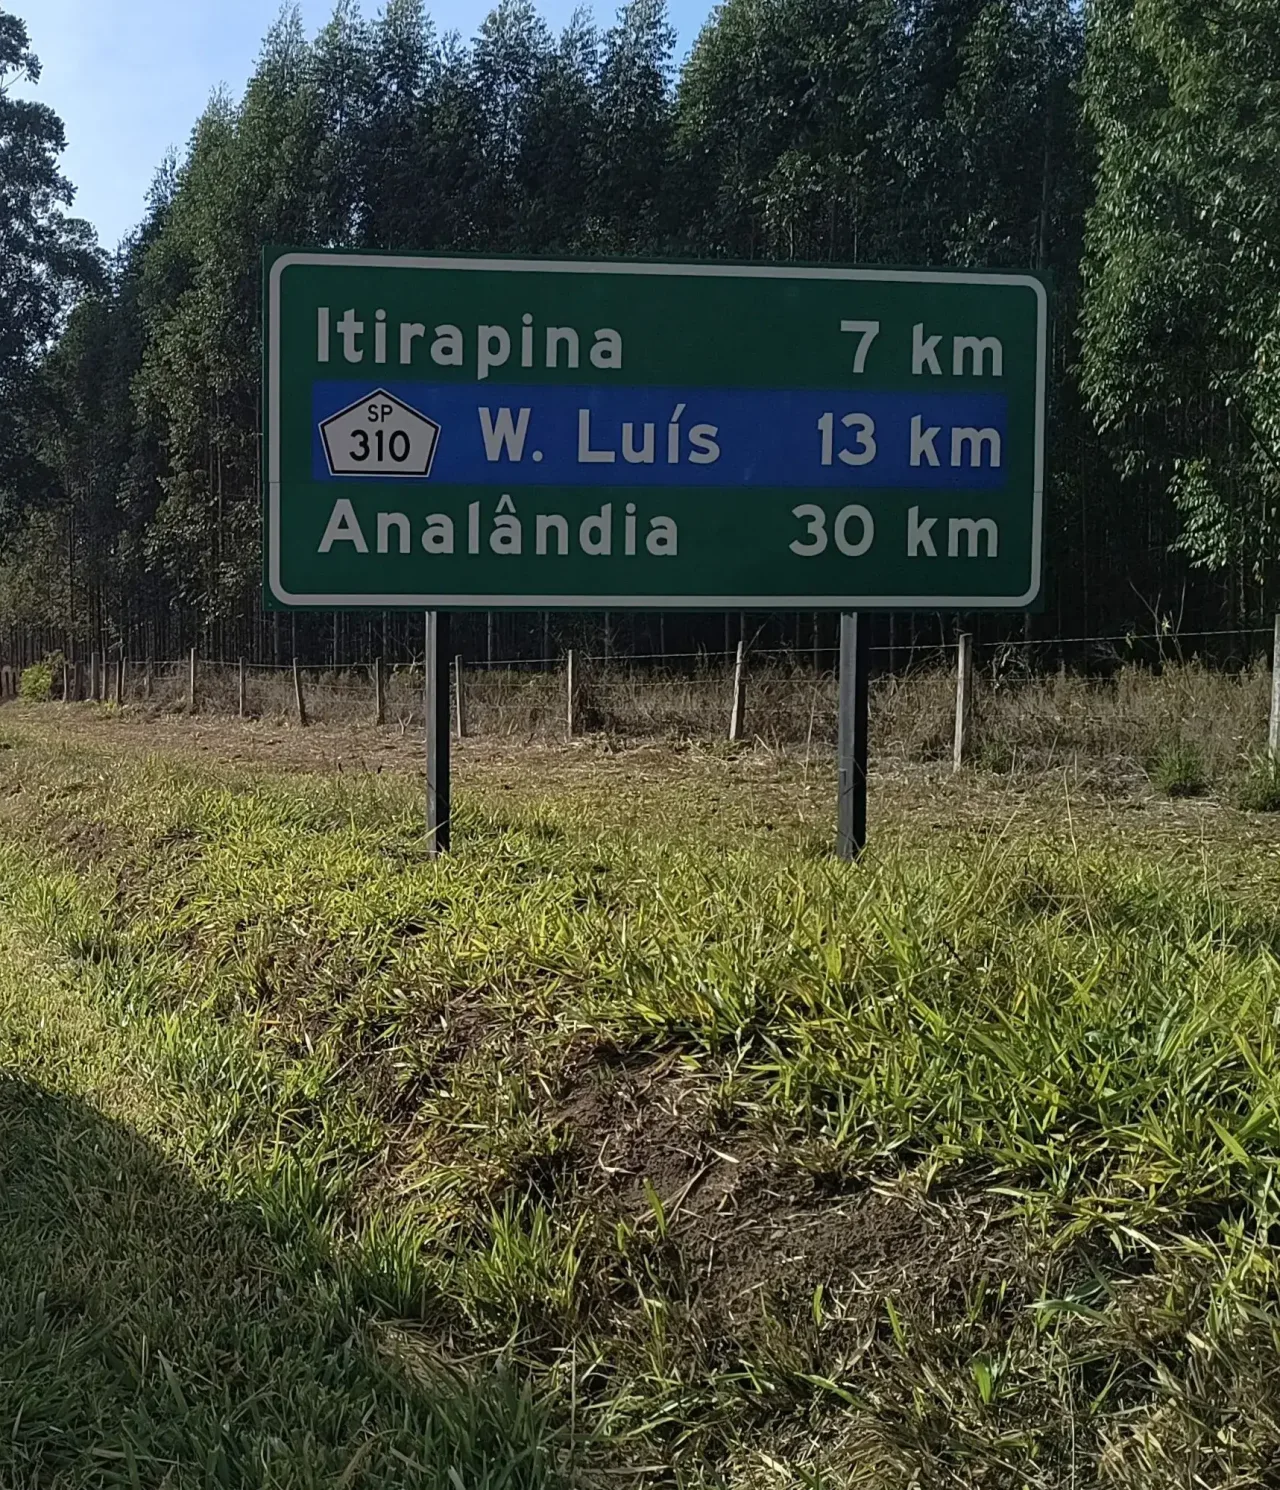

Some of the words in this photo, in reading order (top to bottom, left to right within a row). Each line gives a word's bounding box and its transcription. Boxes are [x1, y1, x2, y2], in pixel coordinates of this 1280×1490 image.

[317, 307, 622, 380] Itirapina
[840, 320, 880, 373] 7
[911, 323, 1003, 377] km
[367, 403, 394, 423] SP
[478, 407, 544, 462] W.
[577, 403, 721, 464] Luís
[817, 412, 877, 465] 13
[909, 415, 1001, 468] km
[348, 429, 411, 463] 310
[317, 494, 679, 556] Analândia
[788, 504, 875, 556] 30
[907, 506, 999, 558] km
